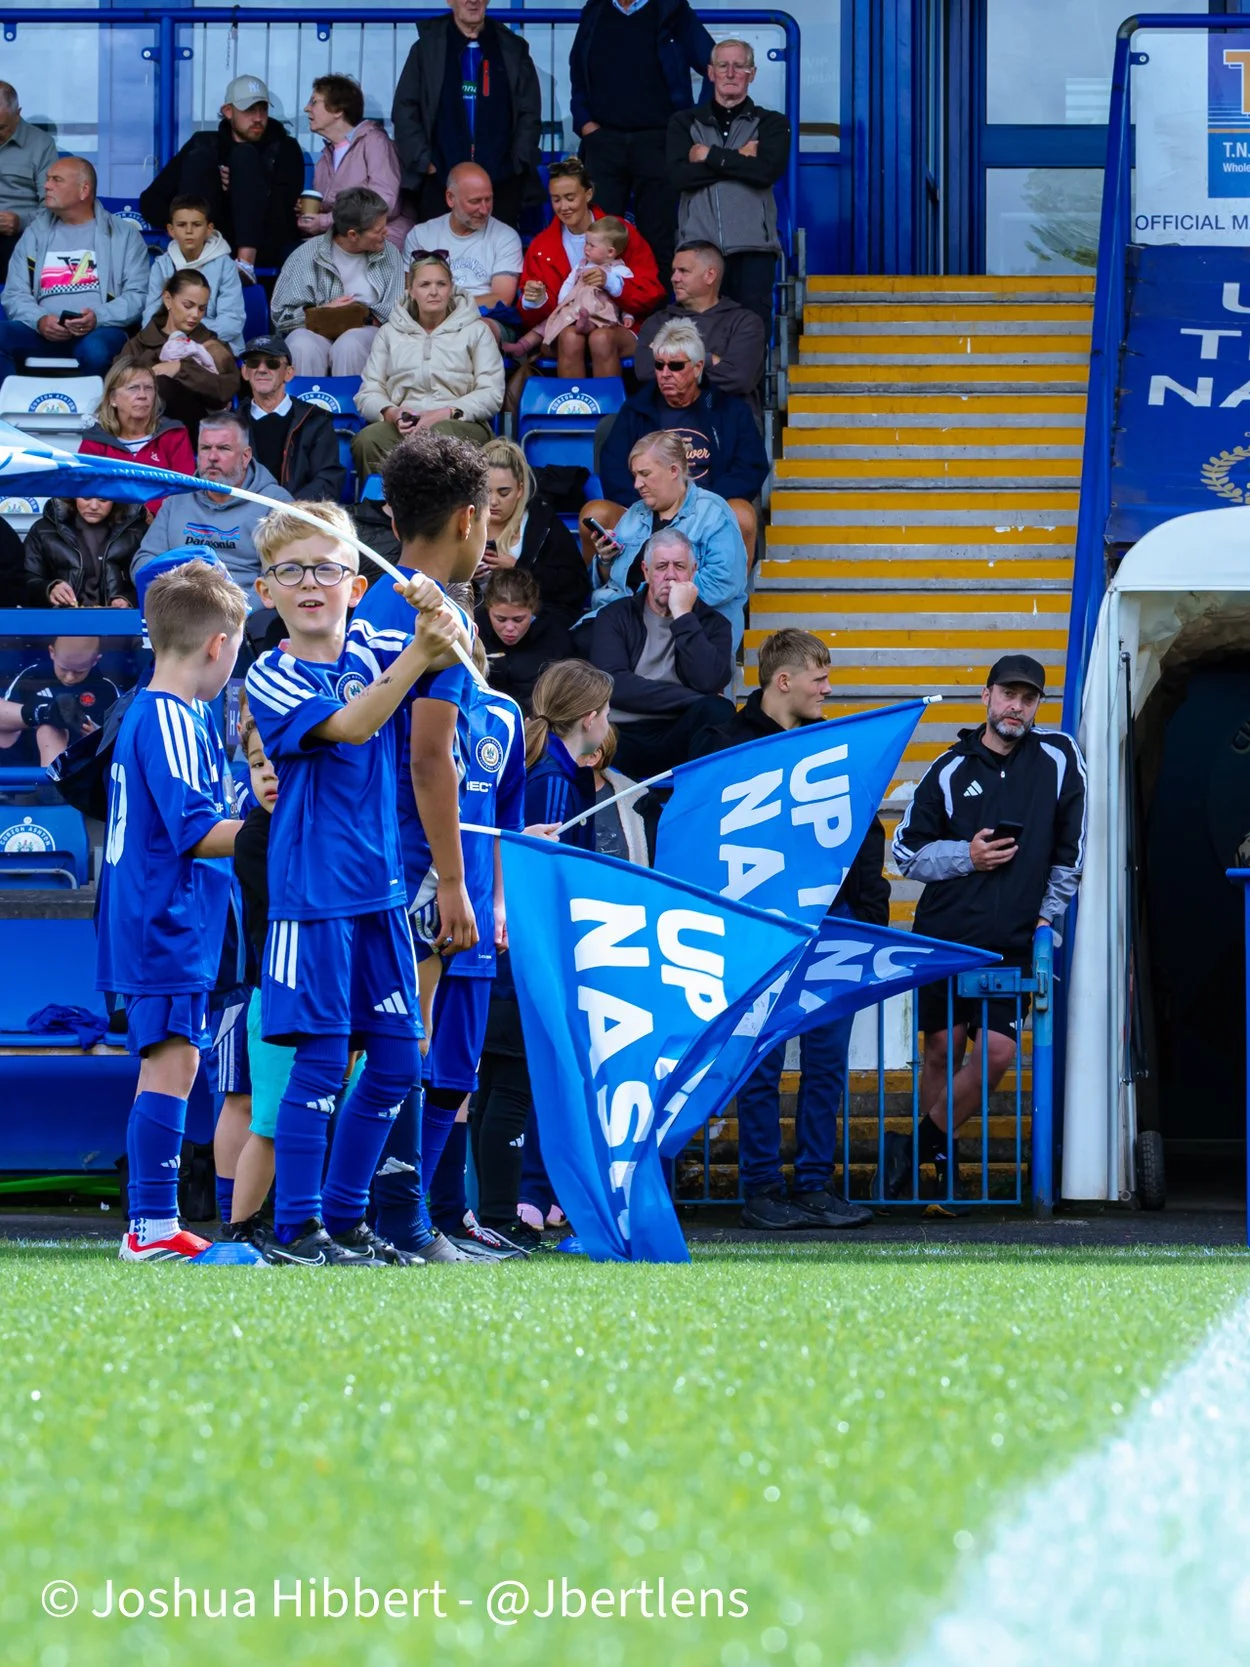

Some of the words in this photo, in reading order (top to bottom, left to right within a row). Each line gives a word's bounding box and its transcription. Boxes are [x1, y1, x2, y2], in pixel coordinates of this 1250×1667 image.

[1135, 214, 1225, 231] OFFICIAL
[789, 743, 853, 849] UP
[656, 908, 729, 1022] UP
